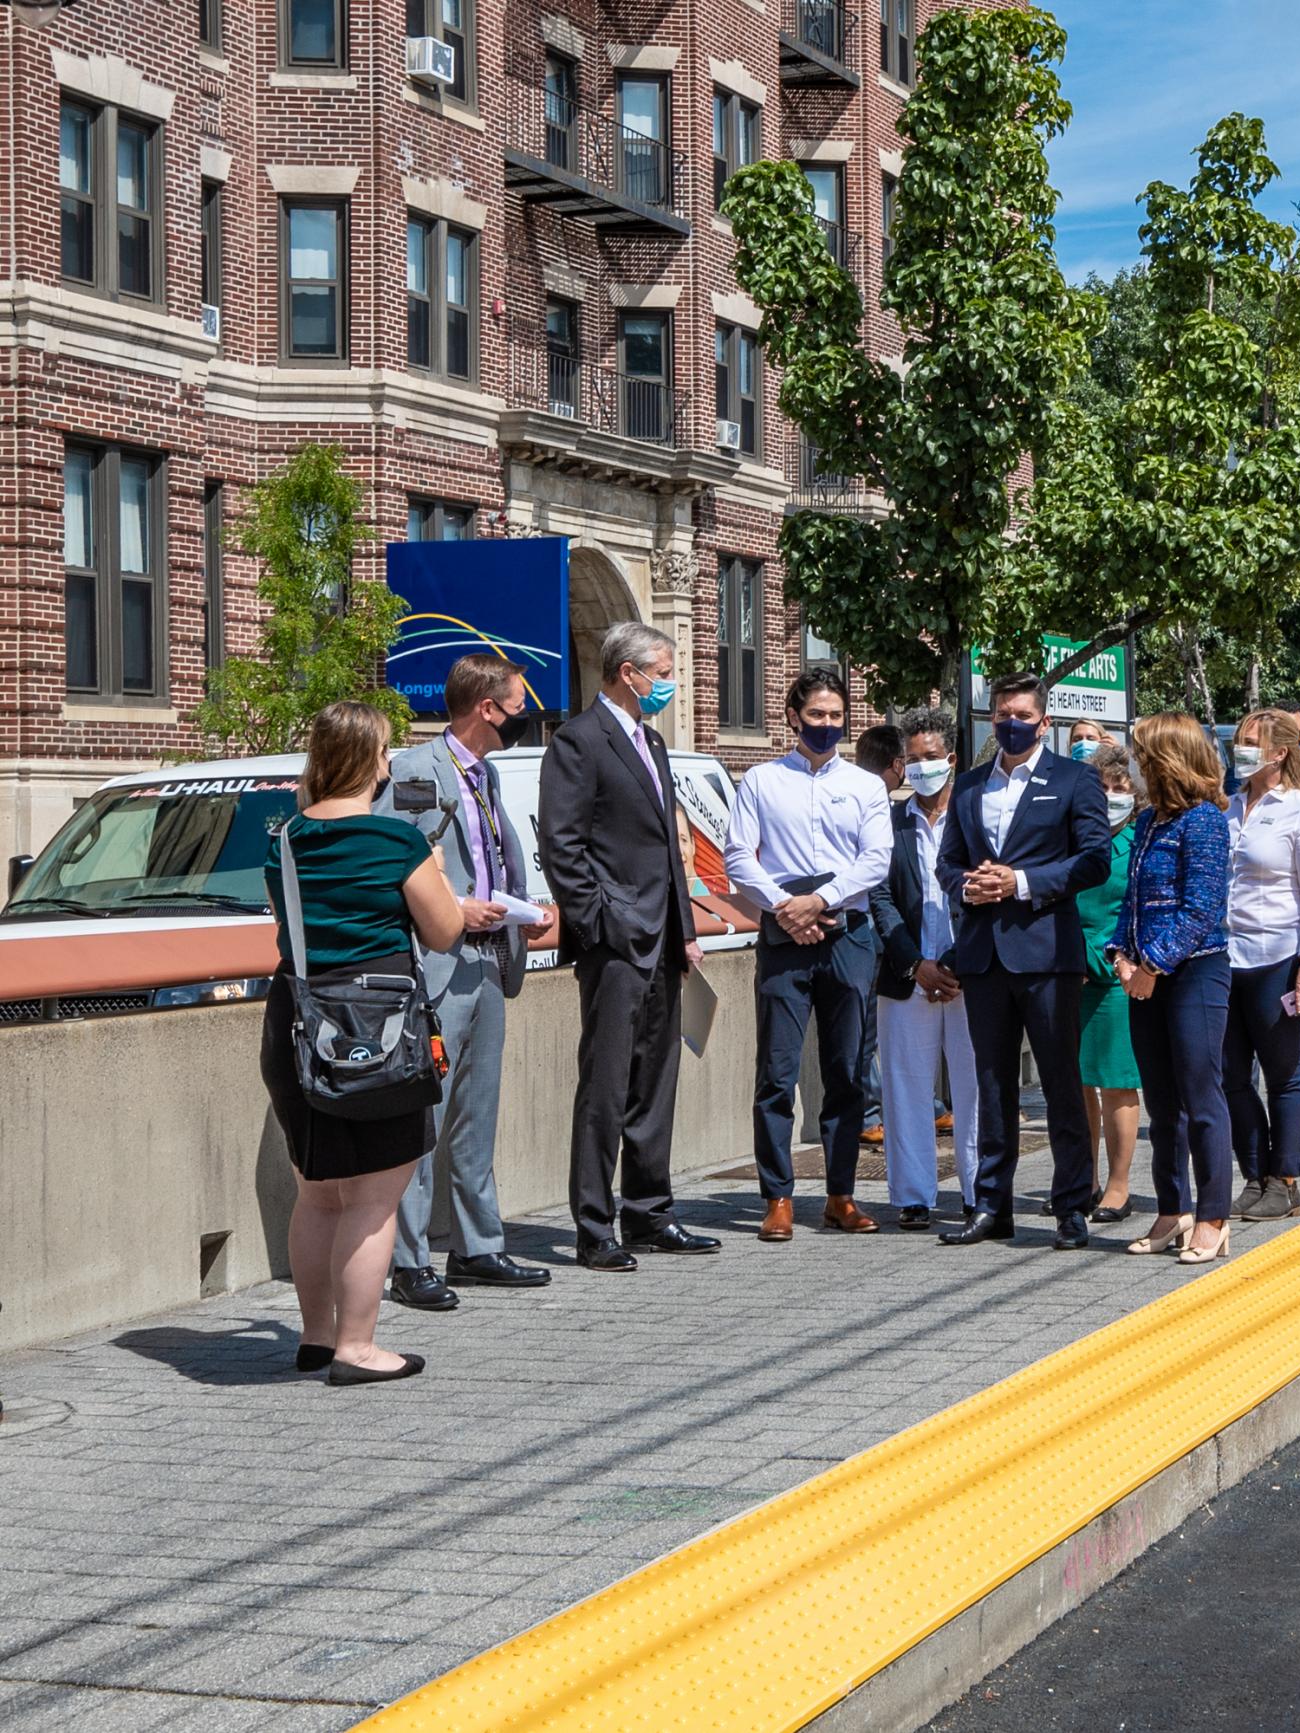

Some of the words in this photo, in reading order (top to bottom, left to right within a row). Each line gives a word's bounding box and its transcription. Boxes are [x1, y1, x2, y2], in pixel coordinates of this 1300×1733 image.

[1089, 653, 1117, 682] ARTS
[1058, 691, 1081, 709] HEATH
[1082, 694, 1107, 712] STREET
[159, 780, 257, 796] U-HAUL
